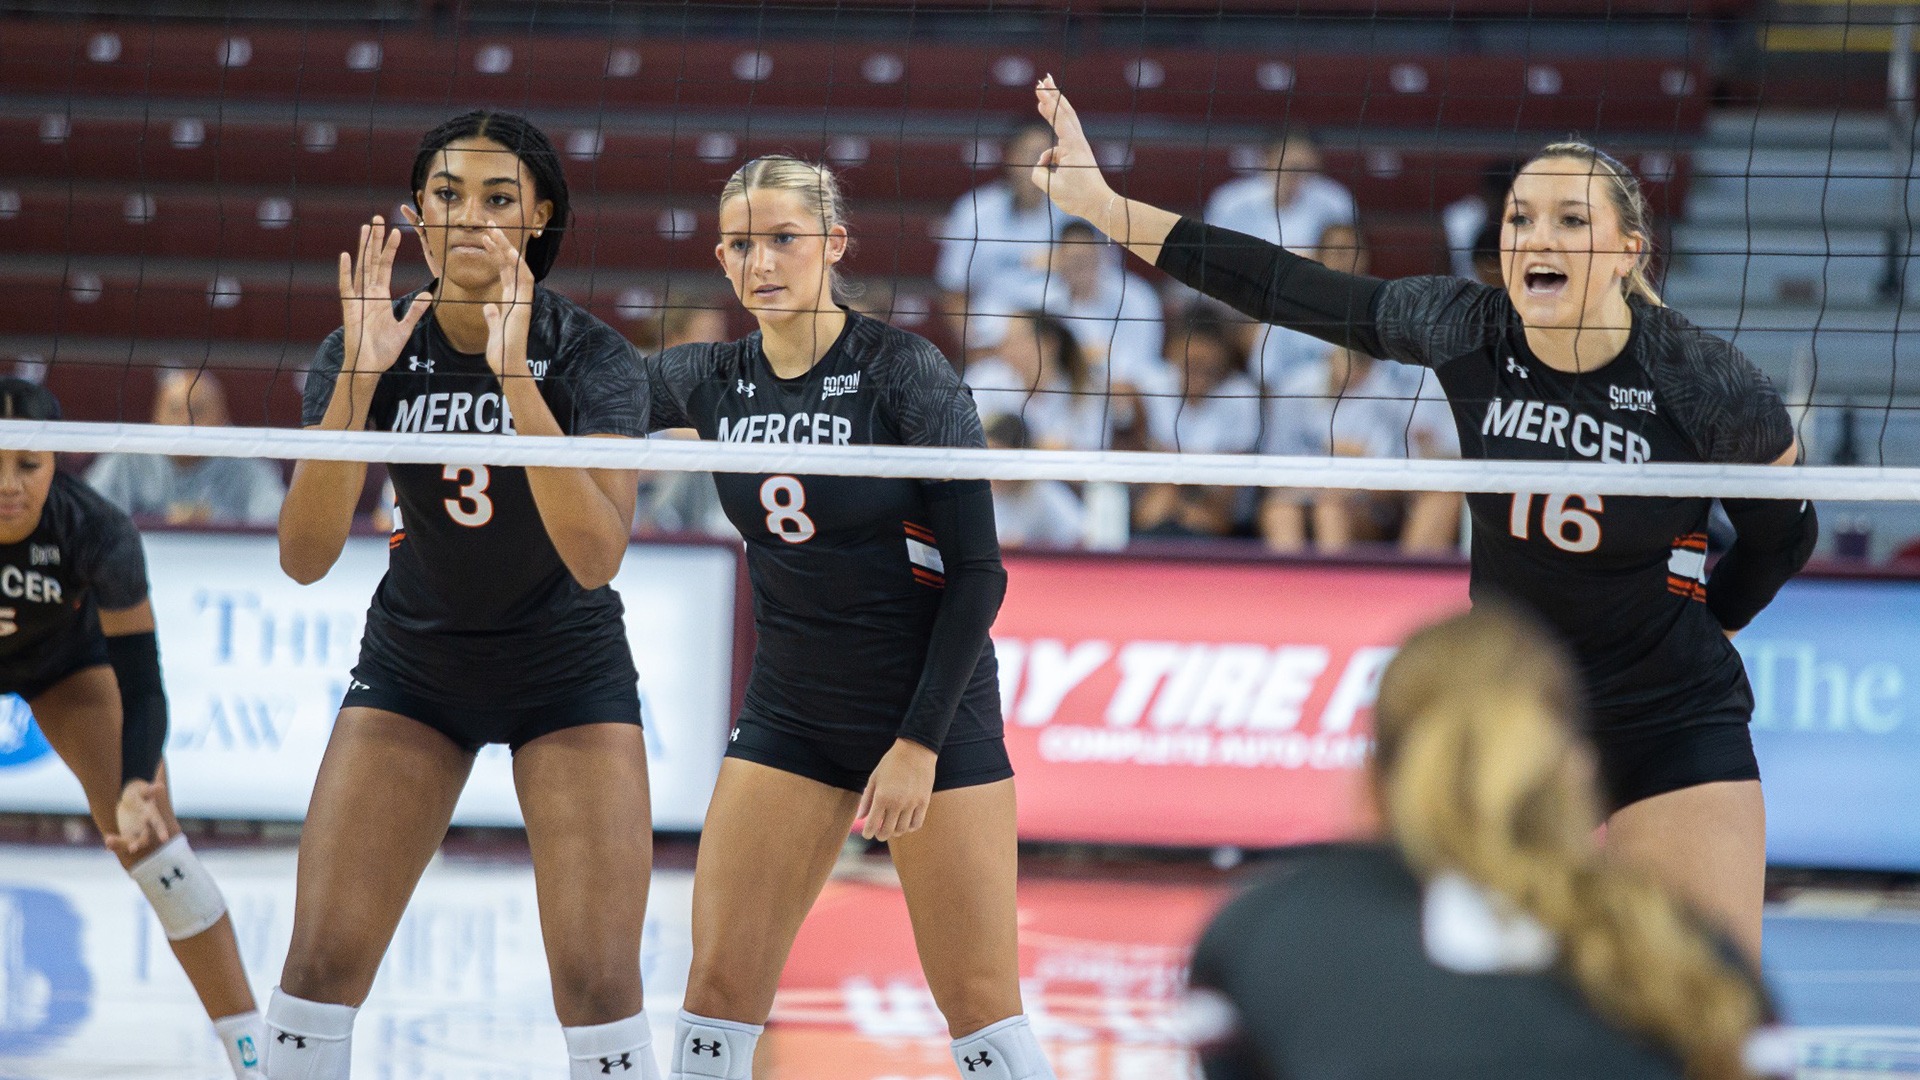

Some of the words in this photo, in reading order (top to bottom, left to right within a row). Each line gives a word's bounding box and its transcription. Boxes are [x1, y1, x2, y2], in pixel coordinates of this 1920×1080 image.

[718, 412, 853, 446] MERCER
[1482, 397, 1651, 465] MERCER
[442, 463, 494, 528] 3
[759, 474, 817, 544] 8
[1509, 491, 1604, 553] 16
[1105, 640, 1329, 731] TIRE
[1741, 639, 1904, 733] The
